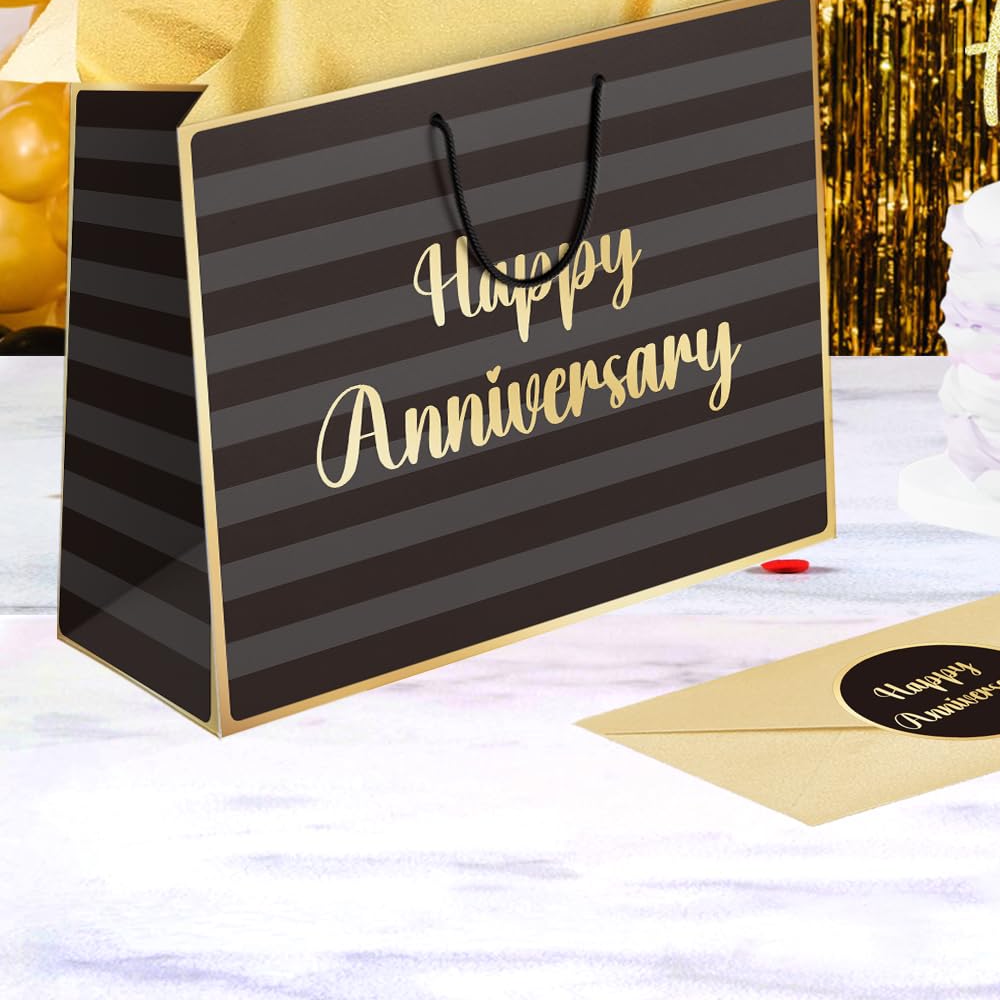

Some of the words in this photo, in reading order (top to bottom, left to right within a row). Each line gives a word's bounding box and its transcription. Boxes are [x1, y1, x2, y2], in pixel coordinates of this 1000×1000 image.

[413, 228, 642, 343] Happy
[316, 321, 742, 488] Anniversary
[873, 661, 982, 700] Happy
